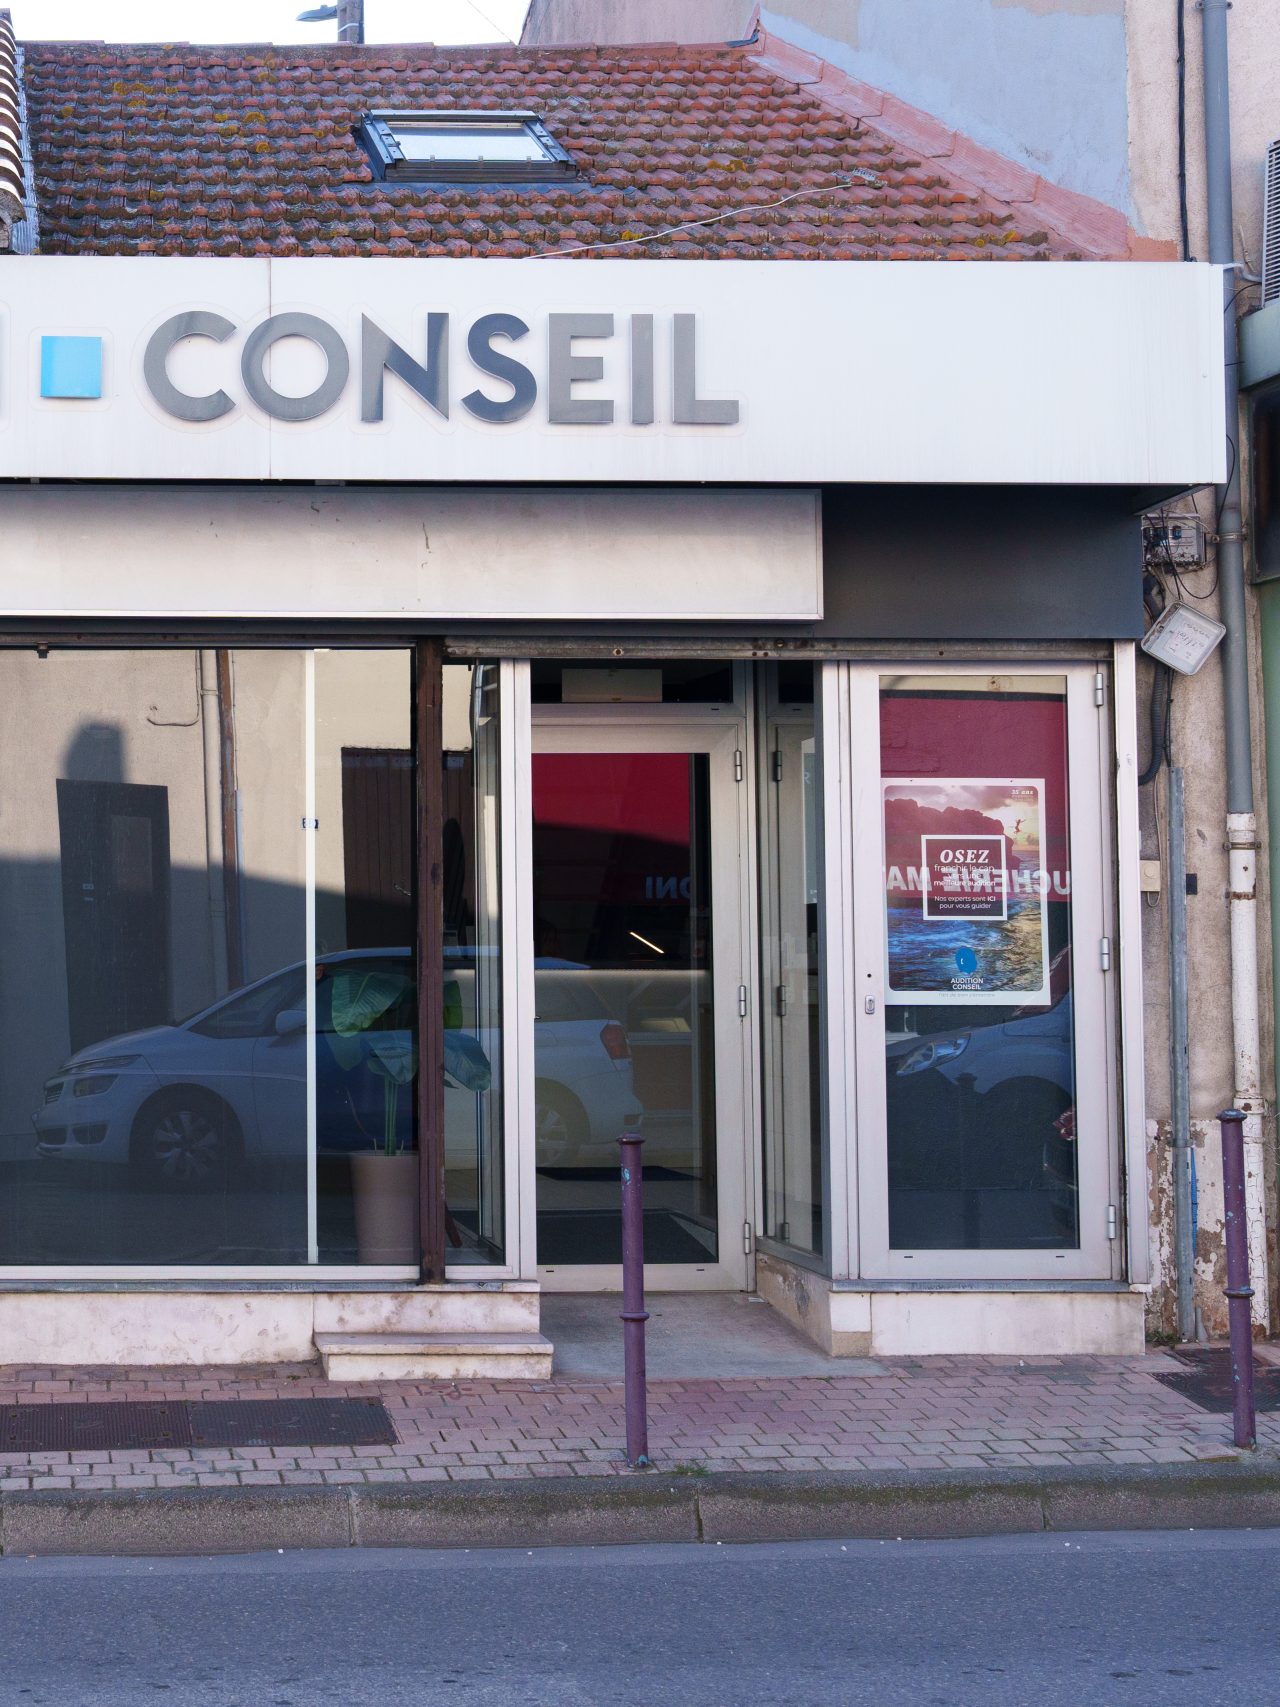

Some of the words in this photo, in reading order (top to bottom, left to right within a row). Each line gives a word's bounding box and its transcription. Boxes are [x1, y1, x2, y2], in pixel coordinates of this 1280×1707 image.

[143, 310, 739, 424] CONSEIL
[940, 849, 990, 864] OSEZ
[934, 864, 968, 872] franchir
[969, 864, 976, 872] le
